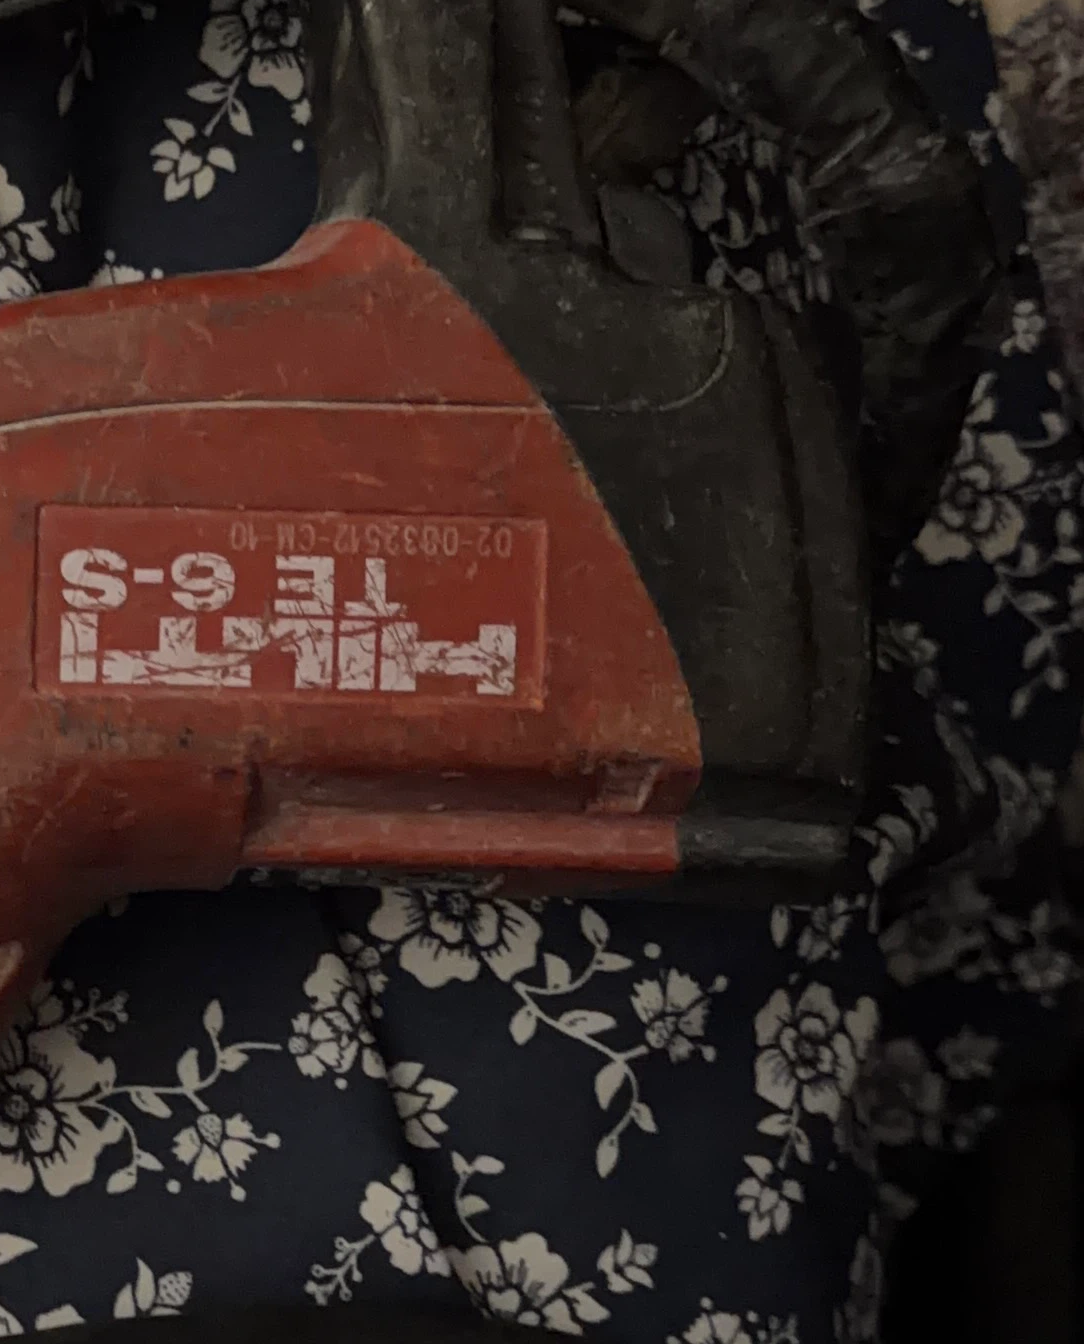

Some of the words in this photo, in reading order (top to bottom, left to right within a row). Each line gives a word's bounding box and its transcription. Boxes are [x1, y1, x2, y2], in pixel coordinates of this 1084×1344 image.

[59, 547, 236, 612] 6-S
[273, 555, 407, 617] TE
[59, 610, 517, 696] HILTI
